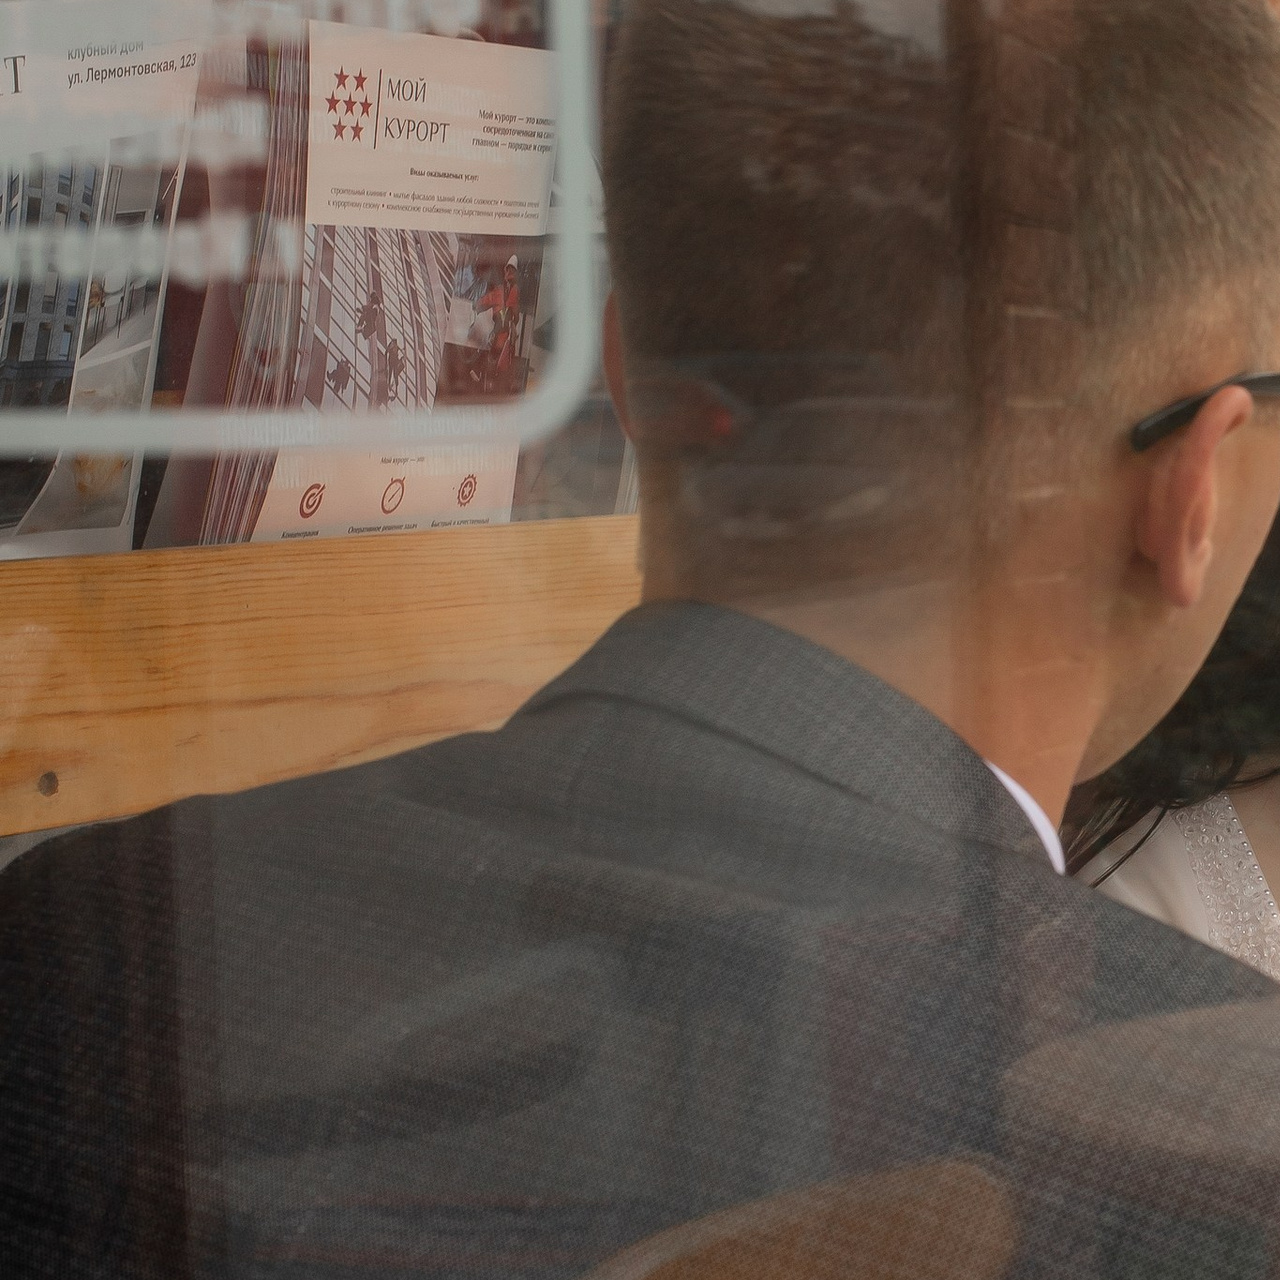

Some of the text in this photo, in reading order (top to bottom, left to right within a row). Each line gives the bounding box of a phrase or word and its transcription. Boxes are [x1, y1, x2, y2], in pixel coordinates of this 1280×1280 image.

[67, 40, 144, 62] клубный дом
[68, 53, 197, 89] ул. Лермонтовская, 123
[387, 77, 427, 103] МОЙ
[478, 109, 493, 120] Мой
[494, 114, 517, 124] курорт
[384, 117, 450, 143] КУРОРТ
